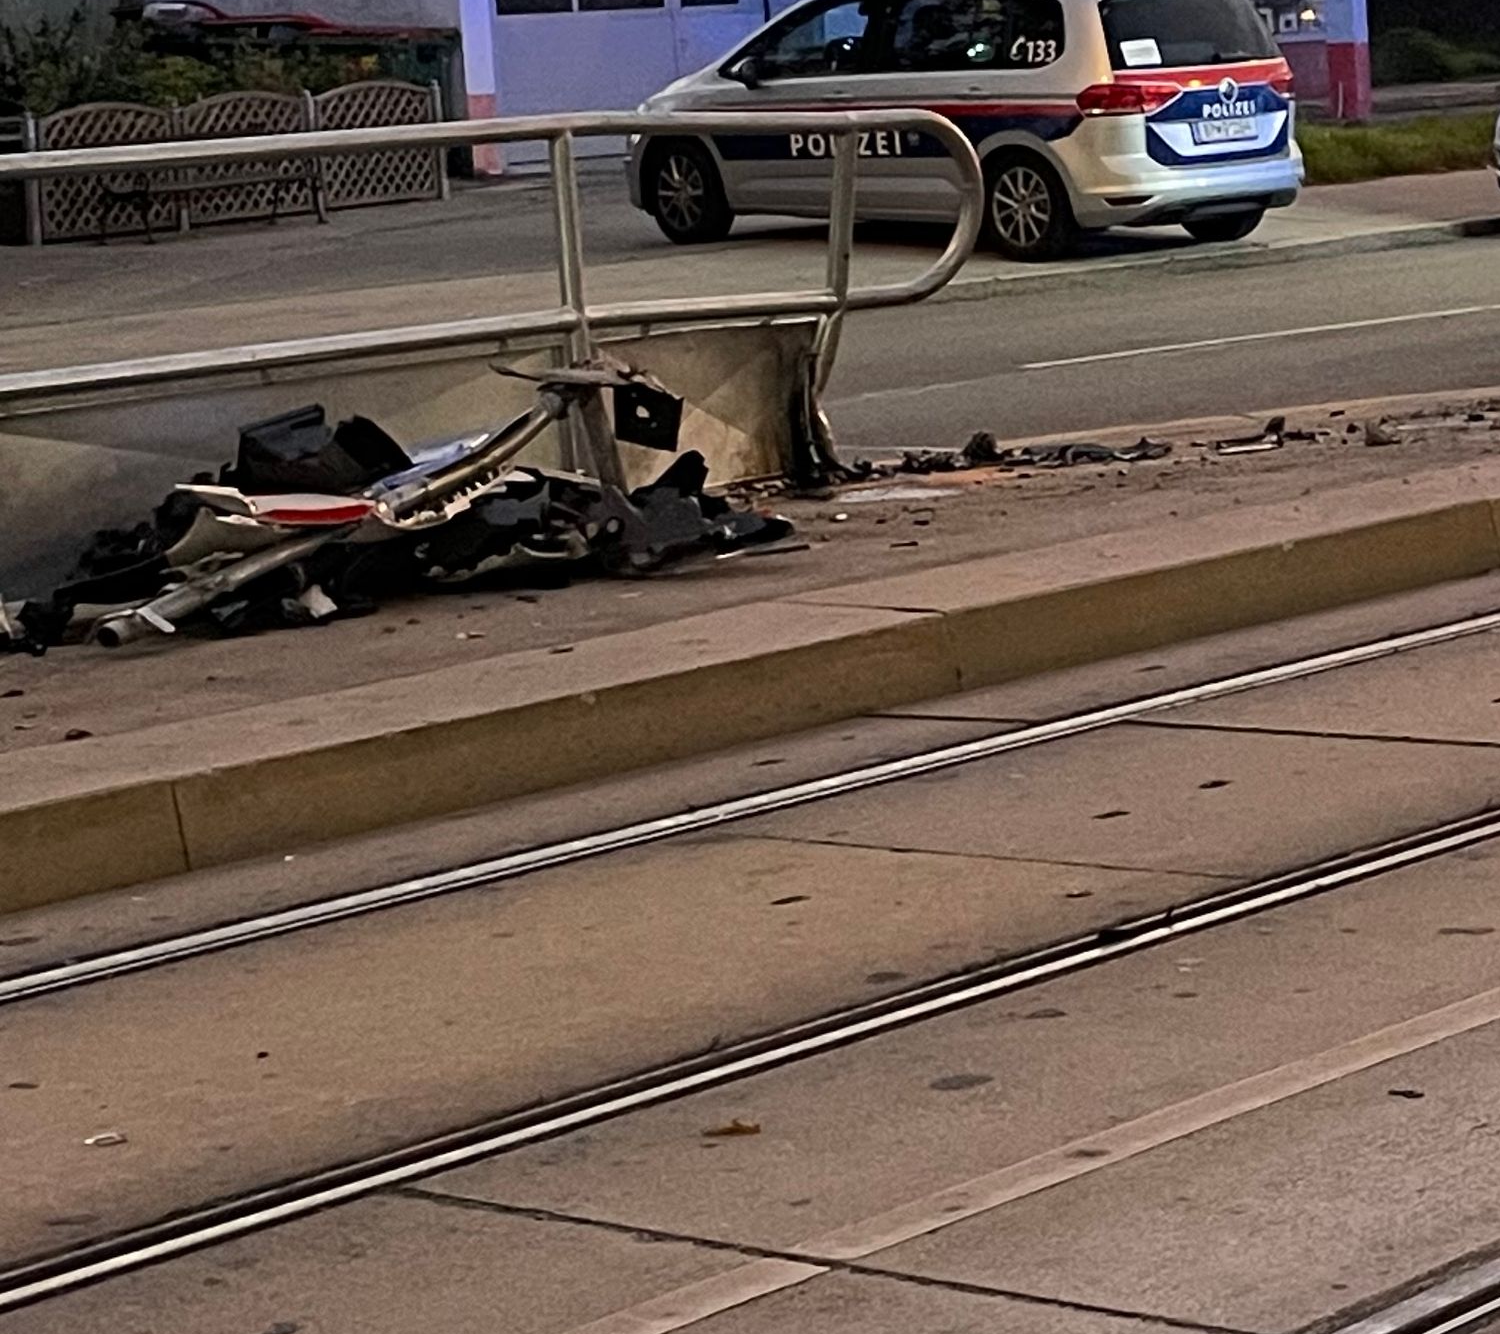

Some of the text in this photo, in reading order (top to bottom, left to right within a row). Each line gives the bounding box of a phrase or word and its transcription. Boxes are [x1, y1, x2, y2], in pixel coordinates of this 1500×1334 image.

[1026, 39, 1056, 63] 133
[1202, 100, 1256, 119] POLIZEI
[790, 131, 902, 157] POLZEI
